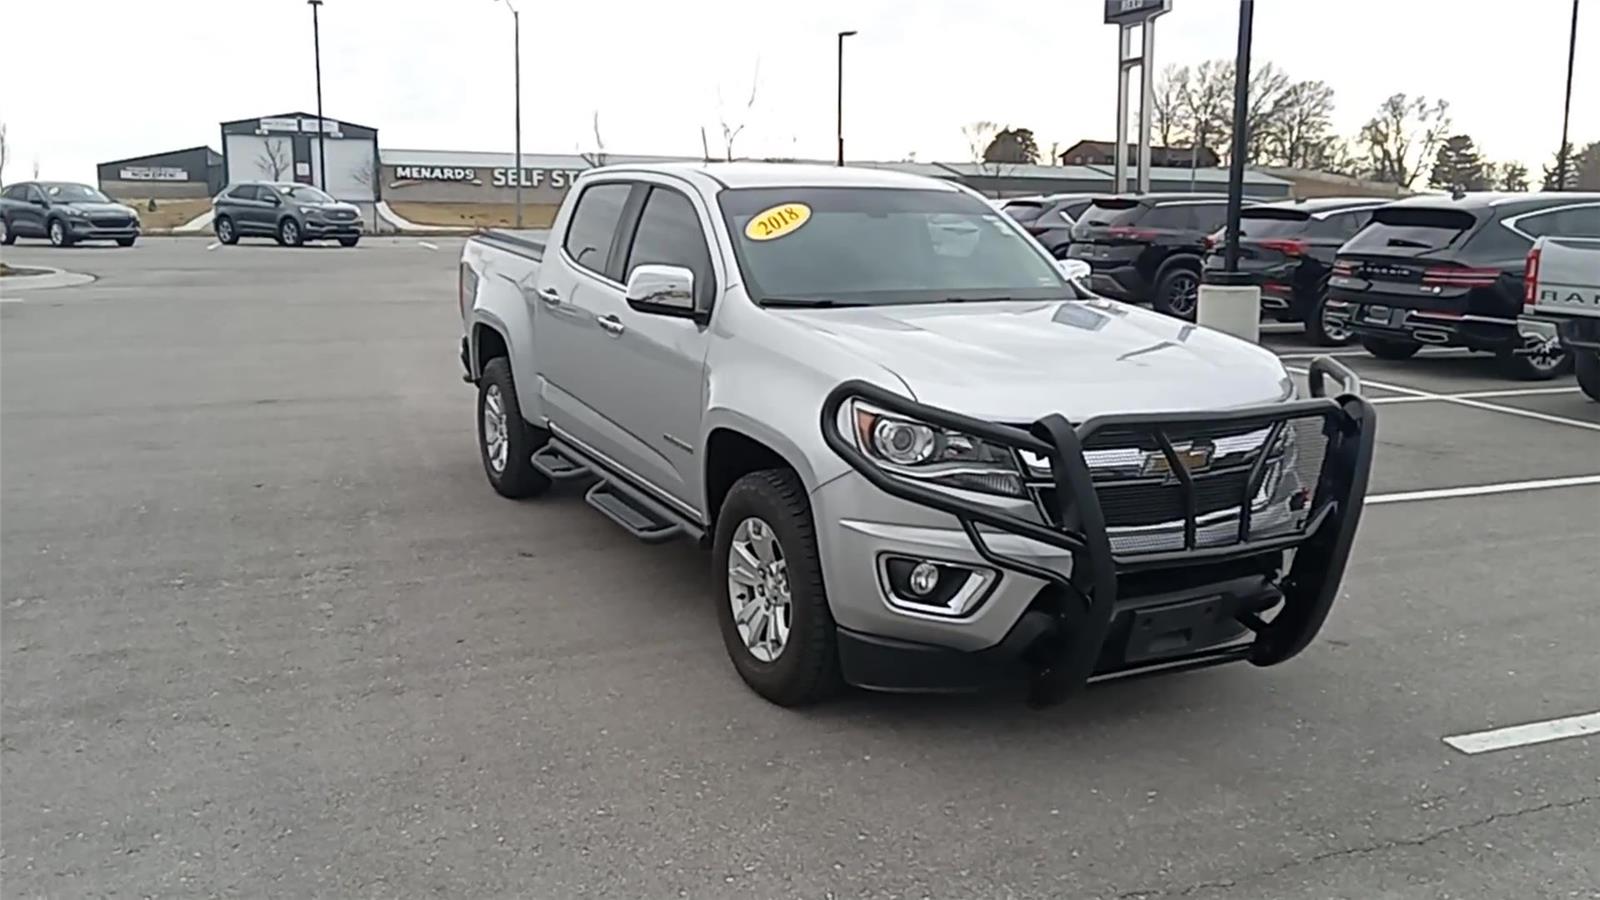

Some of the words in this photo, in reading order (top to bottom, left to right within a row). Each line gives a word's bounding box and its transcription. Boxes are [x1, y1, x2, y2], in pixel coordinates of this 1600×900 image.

[396, 166, 475, 181] MENARDS
[493, 168, 544, 187] SELF
[757, 206, 800, 236] 2018
